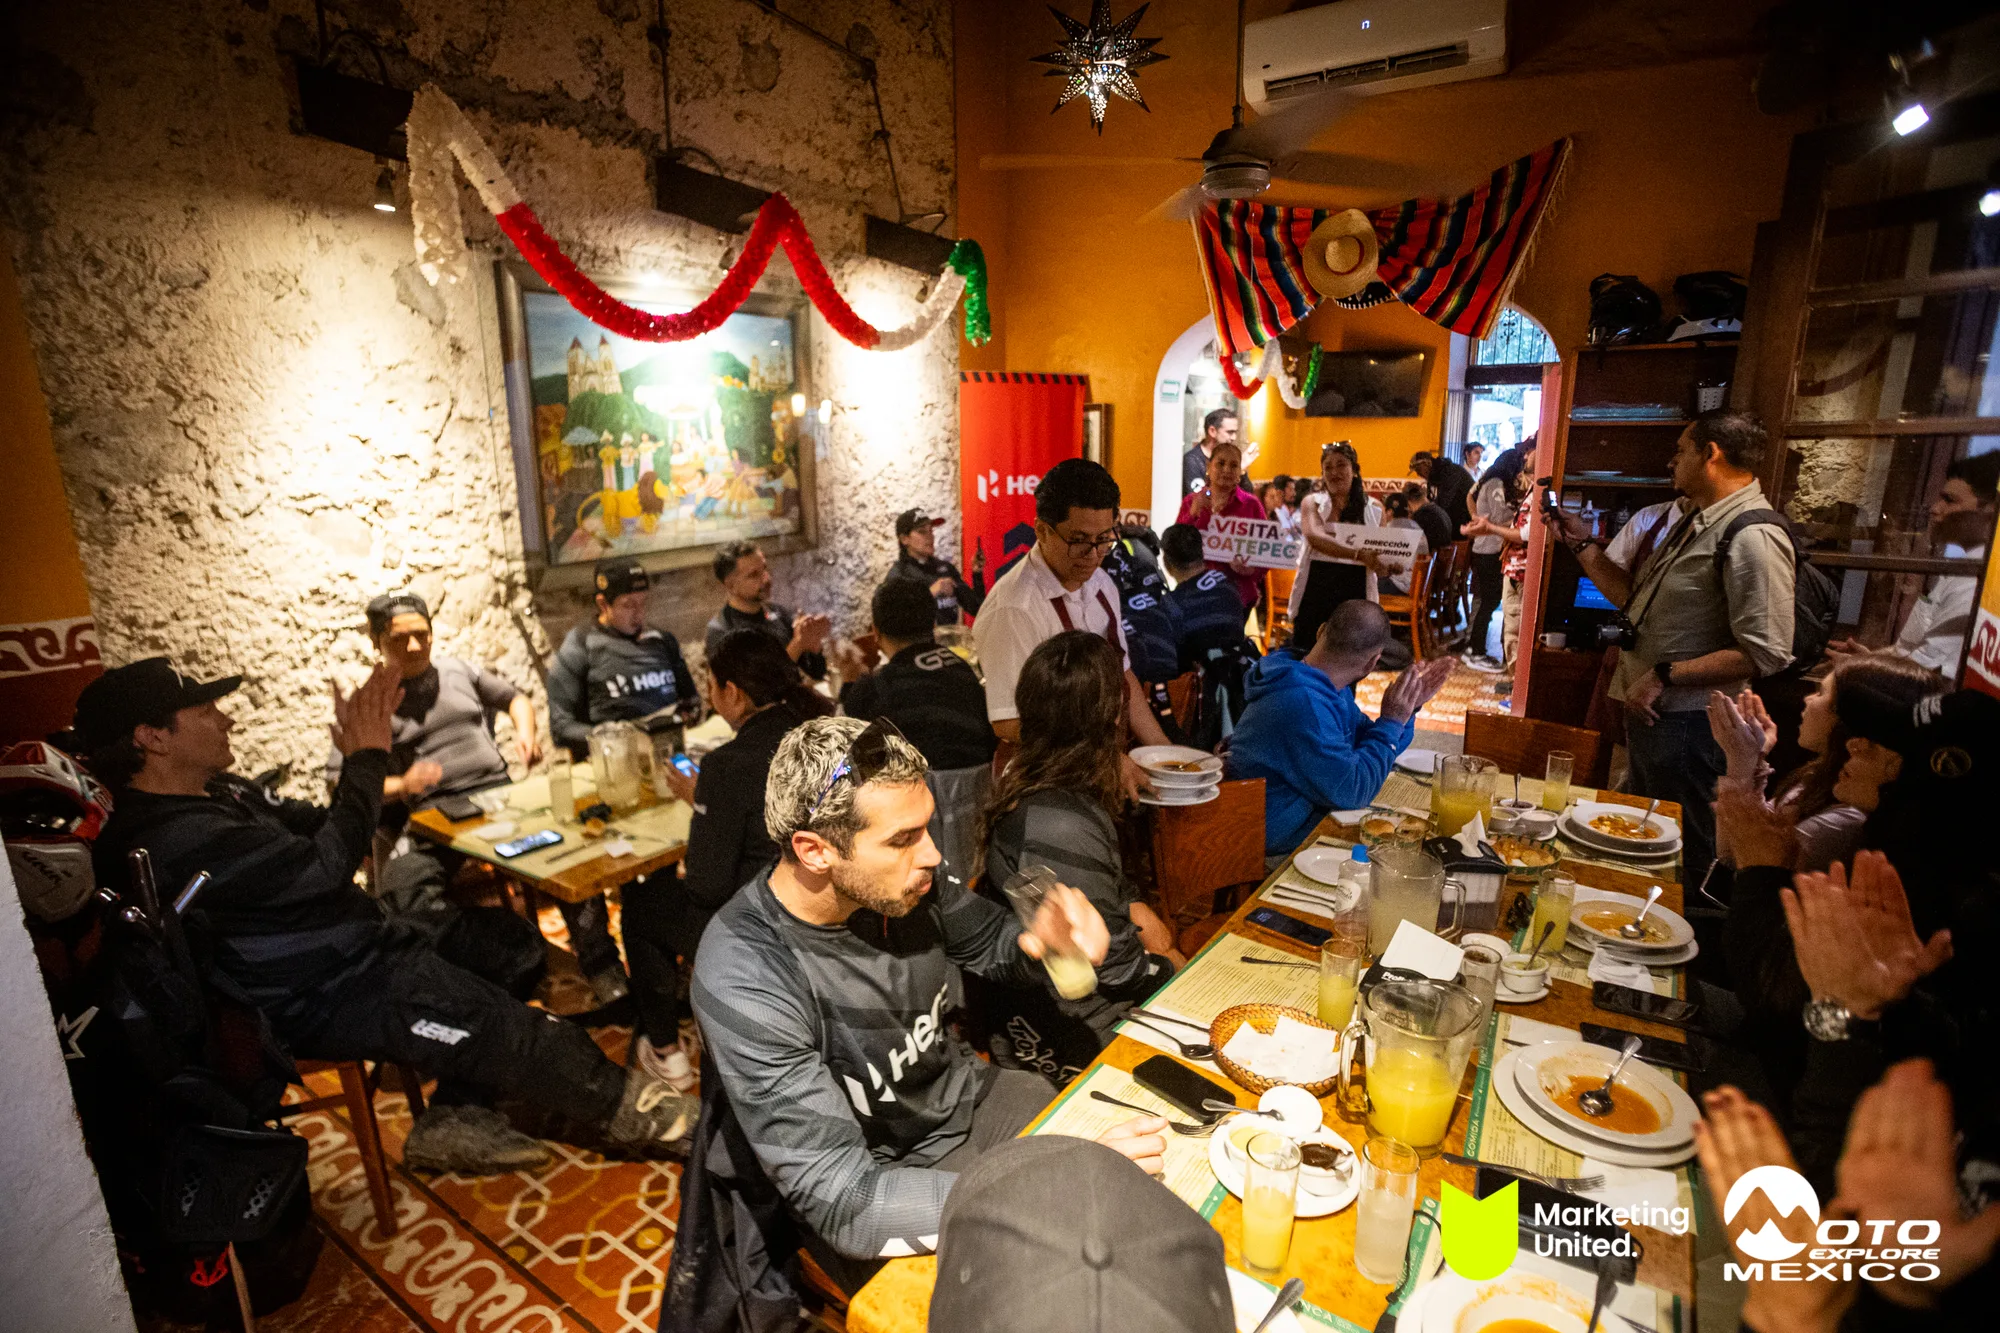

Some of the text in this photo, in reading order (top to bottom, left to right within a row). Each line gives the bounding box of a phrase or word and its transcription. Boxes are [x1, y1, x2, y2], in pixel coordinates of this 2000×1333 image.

[1213, 519, 1279, 540] VISITA
[1203, 534, 1297, 559] OATEPEC
[1466, 1119, 1480, 1158] COMIDA
